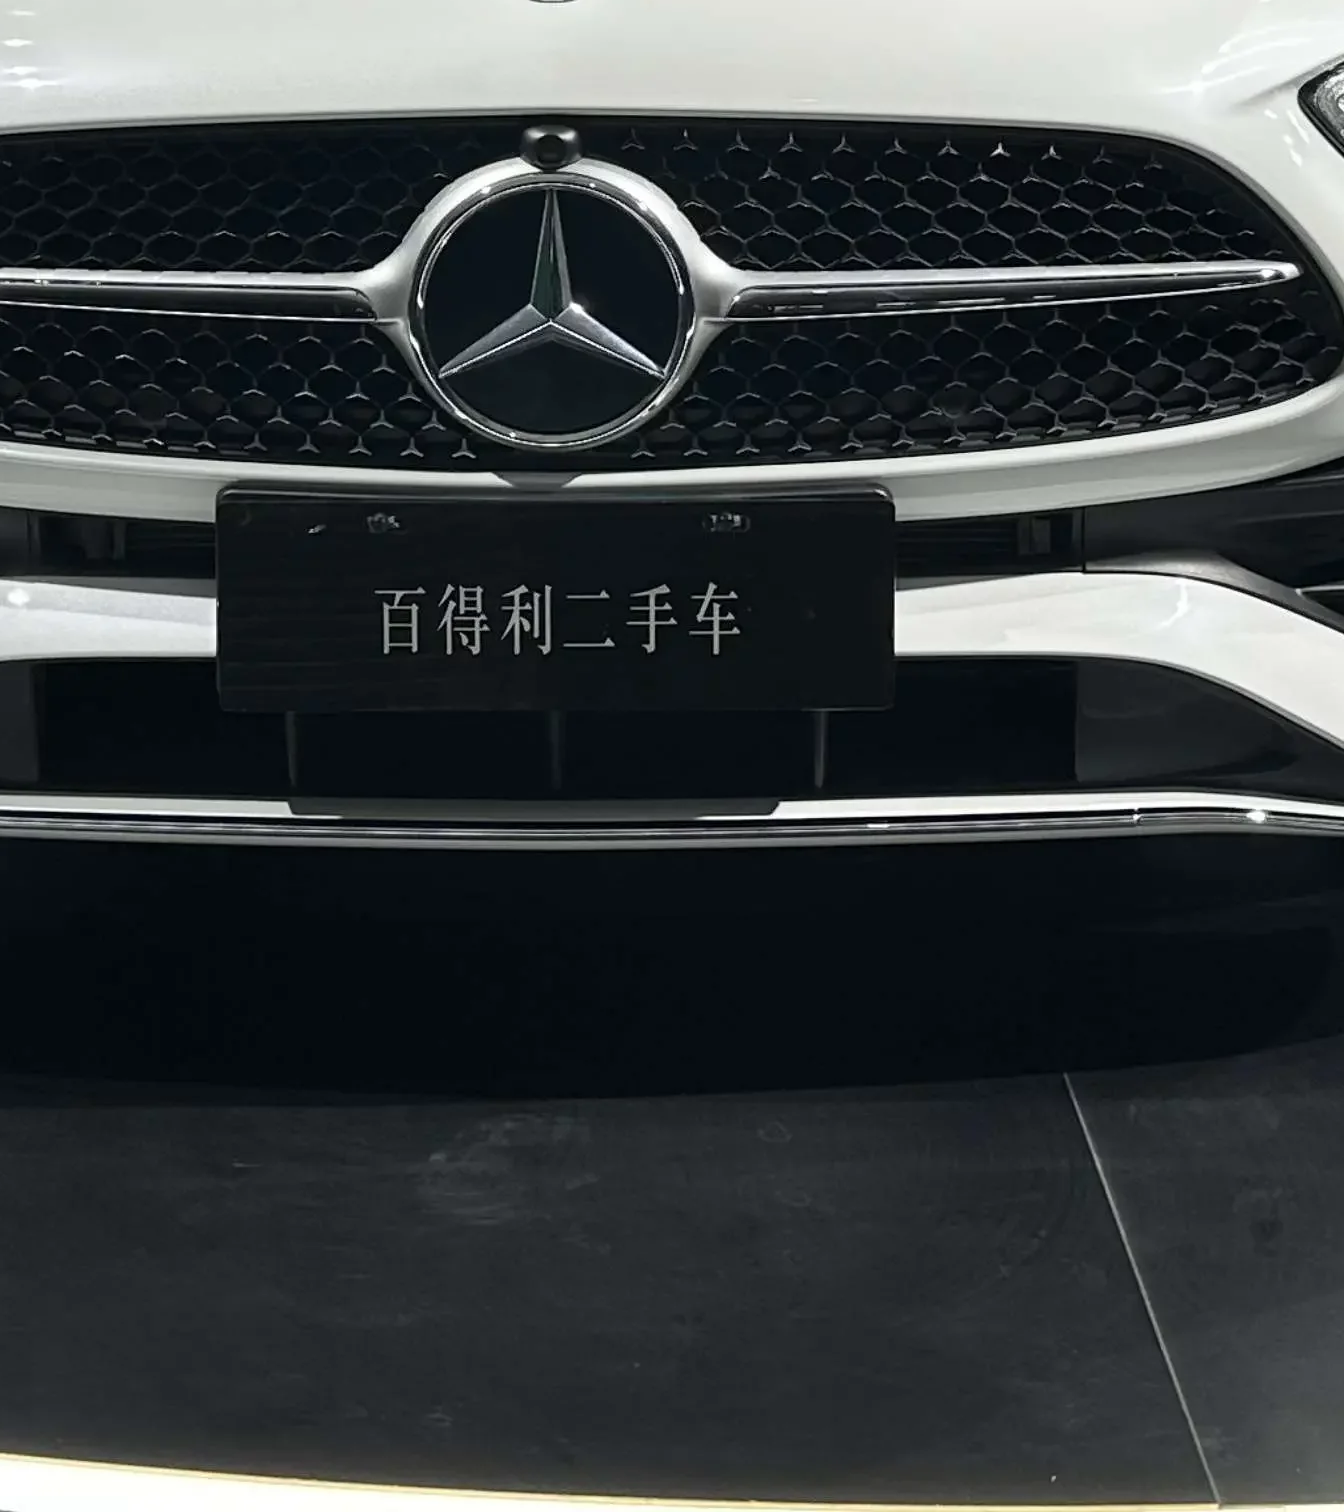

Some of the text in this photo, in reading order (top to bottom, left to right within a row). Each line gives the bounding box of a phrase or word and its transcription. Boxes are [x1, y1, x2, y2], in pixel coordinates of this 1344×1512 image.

[374, 583, 741, 656] 百得利二手车
